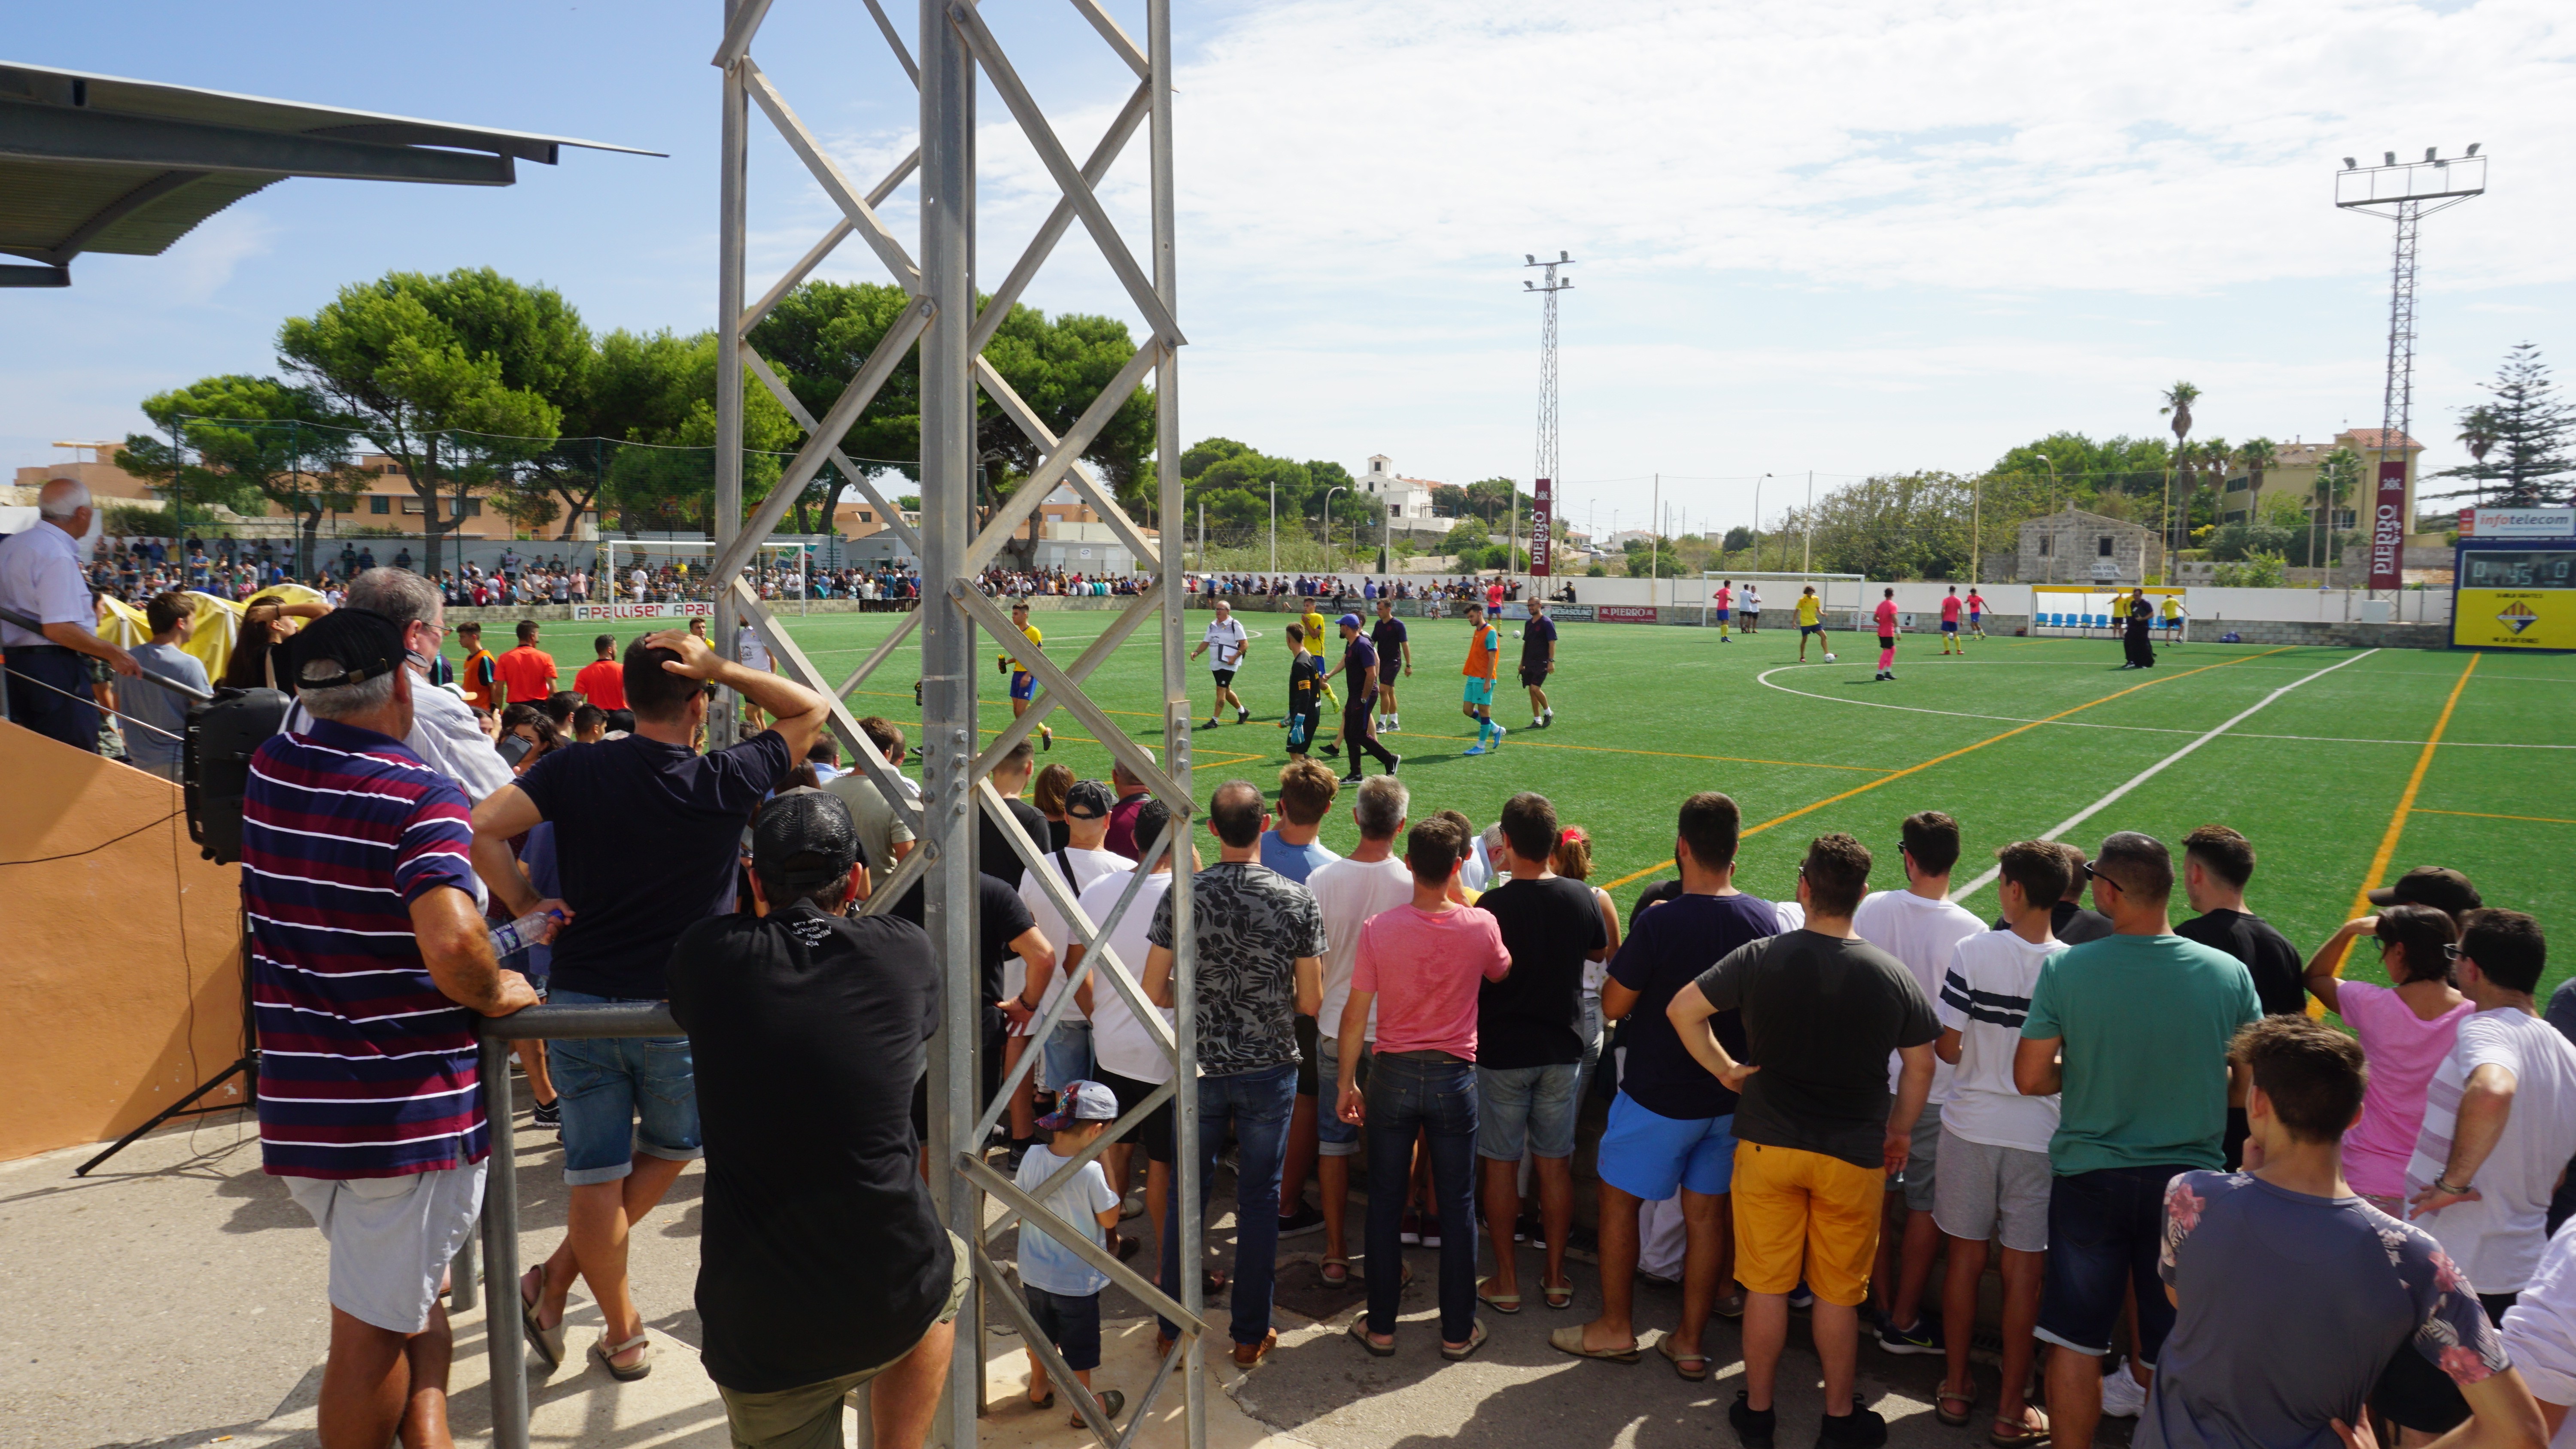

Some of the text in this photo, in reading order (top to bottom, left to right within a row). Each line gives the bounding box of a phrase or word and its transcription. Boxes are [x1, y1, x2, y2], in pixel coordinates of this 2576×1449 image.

[2479, 514, 2569, 527] infotelecom
[1533, 511, 1545, 565] PIERRO
[2373, 504, 2394, 574] PIERRO
[1610, 607, 1646, 616] PIERRO
